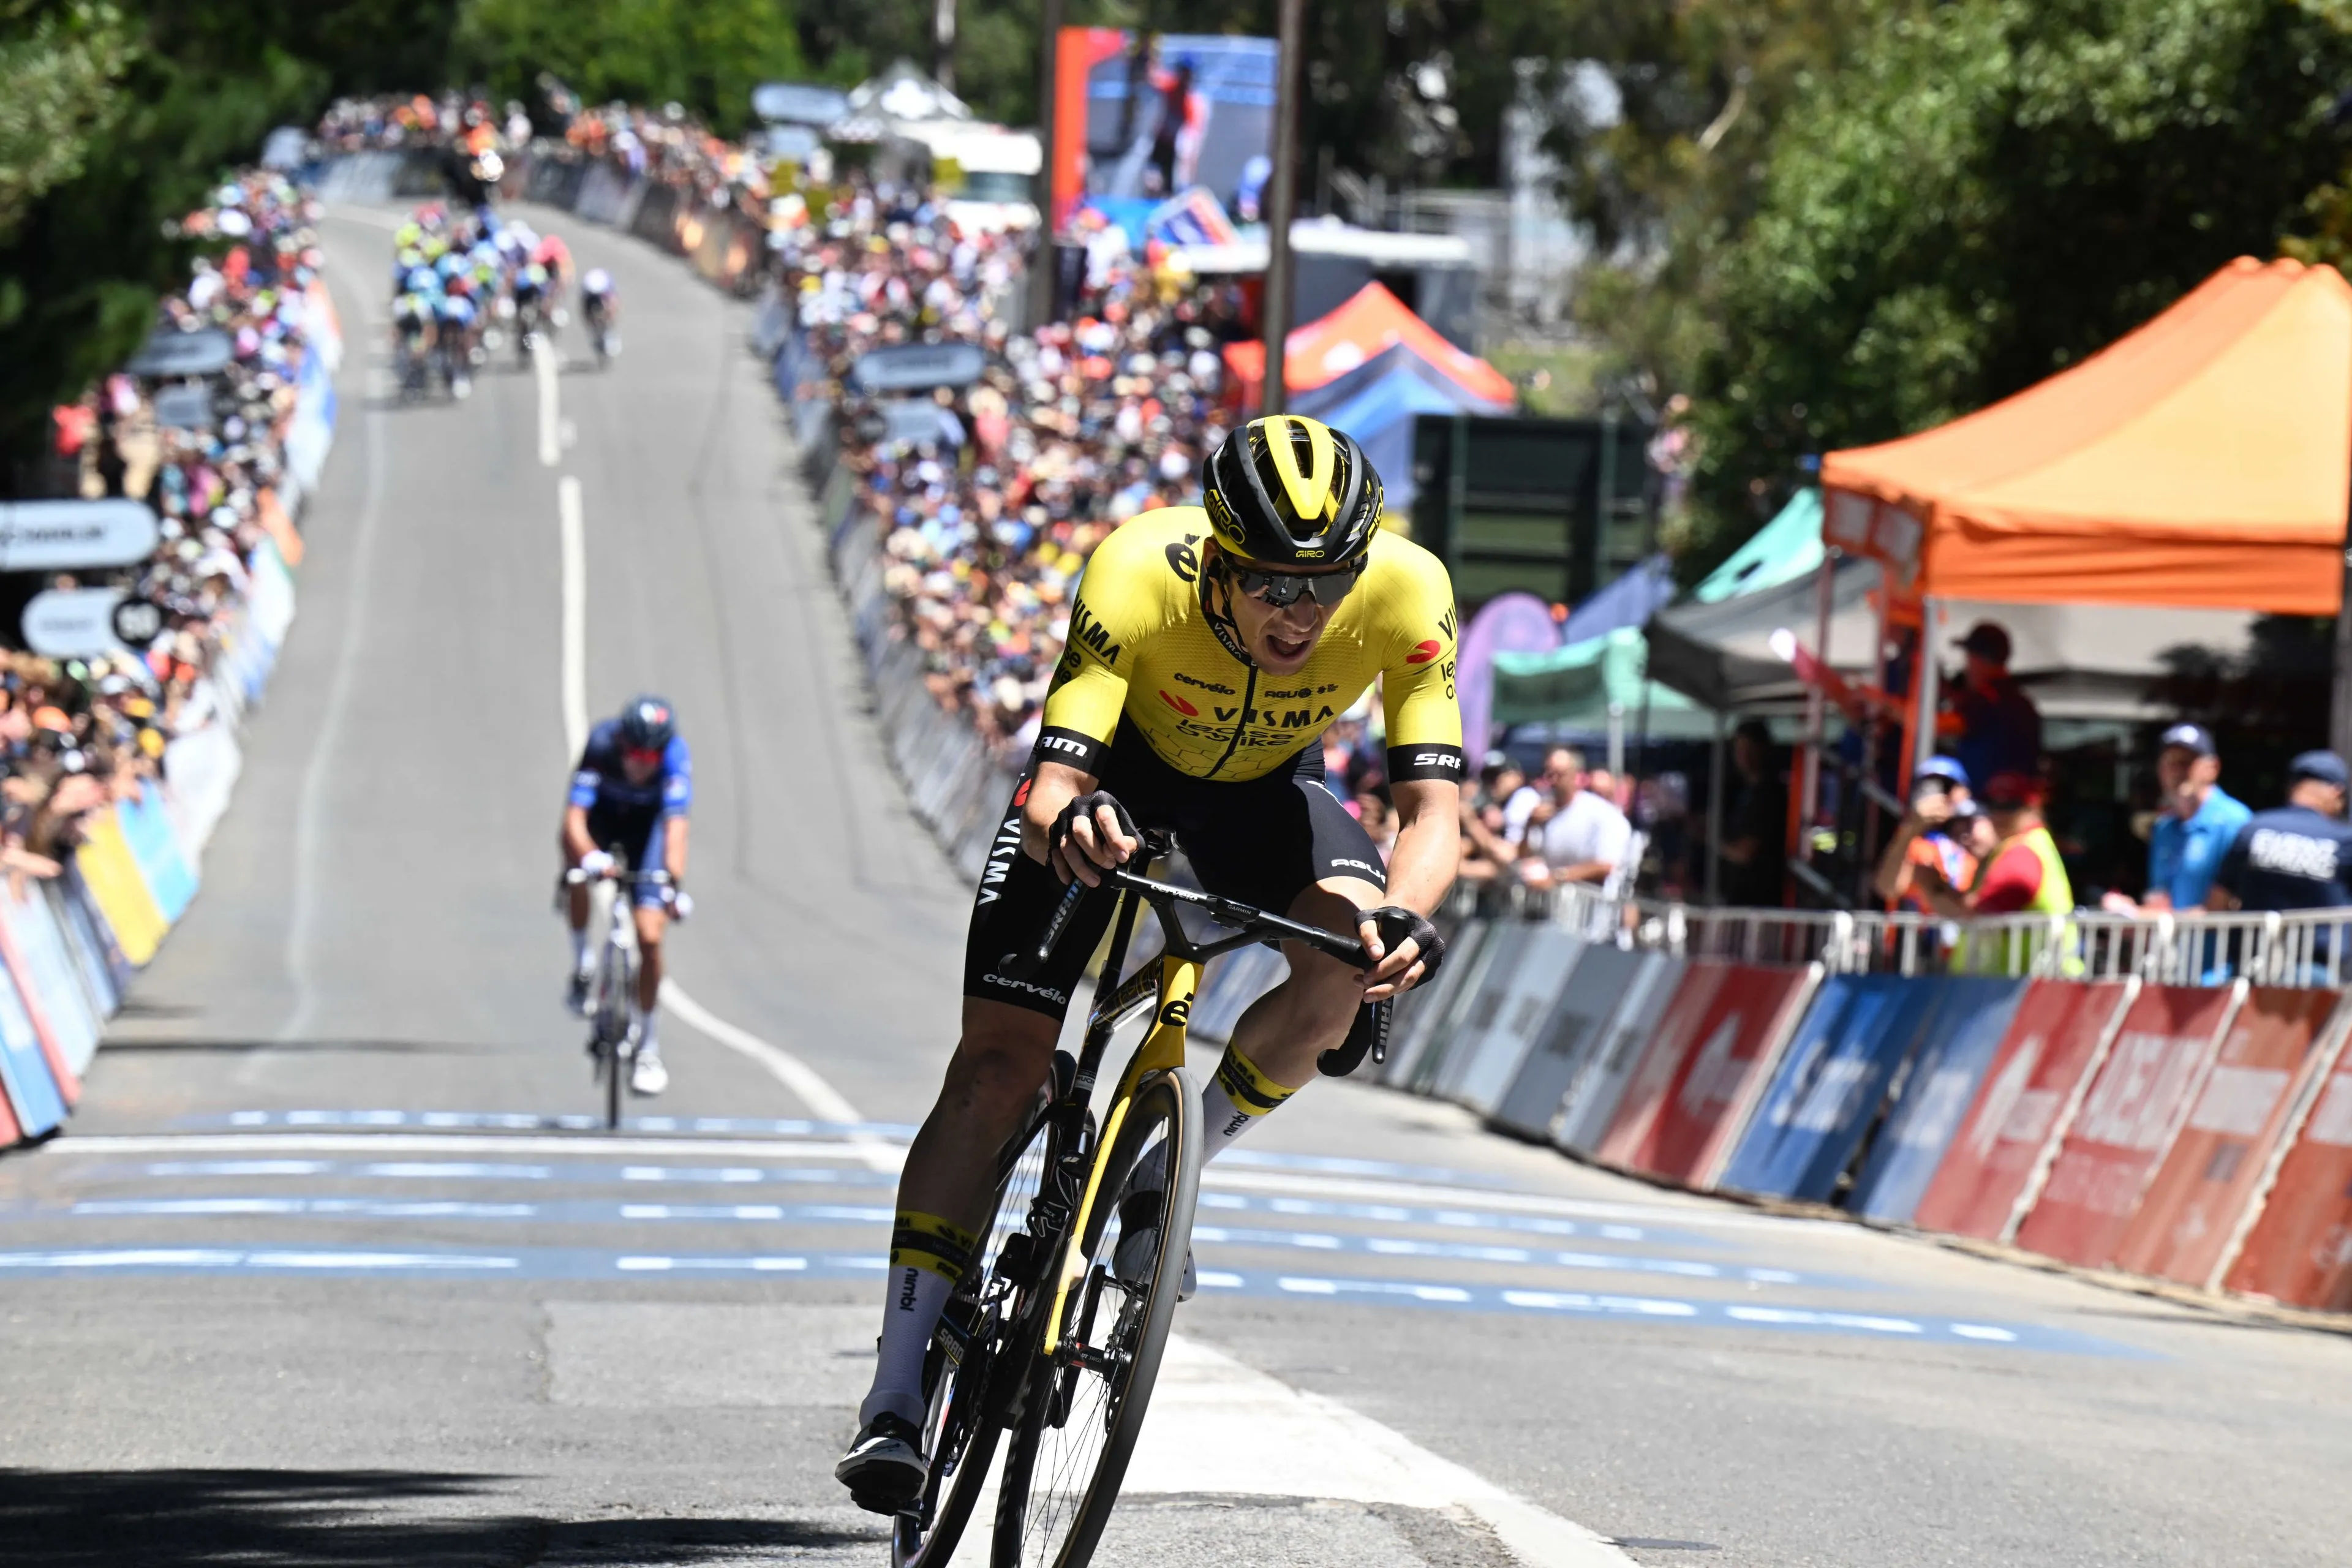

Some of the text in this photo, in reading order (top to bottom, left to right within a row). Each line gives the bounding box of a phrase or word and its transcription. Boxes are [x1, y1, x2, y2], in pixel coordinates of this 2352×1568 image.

[1208, 489, 1245, 545] GIRO
[1438, 601, 1457, 641] VI
[1215, 622, 1242, 659] VISMA
[1214, 705, 1334, 728] VISMA
[977, 818, 1022, 907] VISMA
[1227, 903, 1252, 915] GARMIN
[982, 973, 1067, 1005] cervélo
[1223, 1110, 1251, 1137] nimbl
[899, 1267, 919, 1312] nimbl
[1088, 1355, 1102, 1363] SWISS
